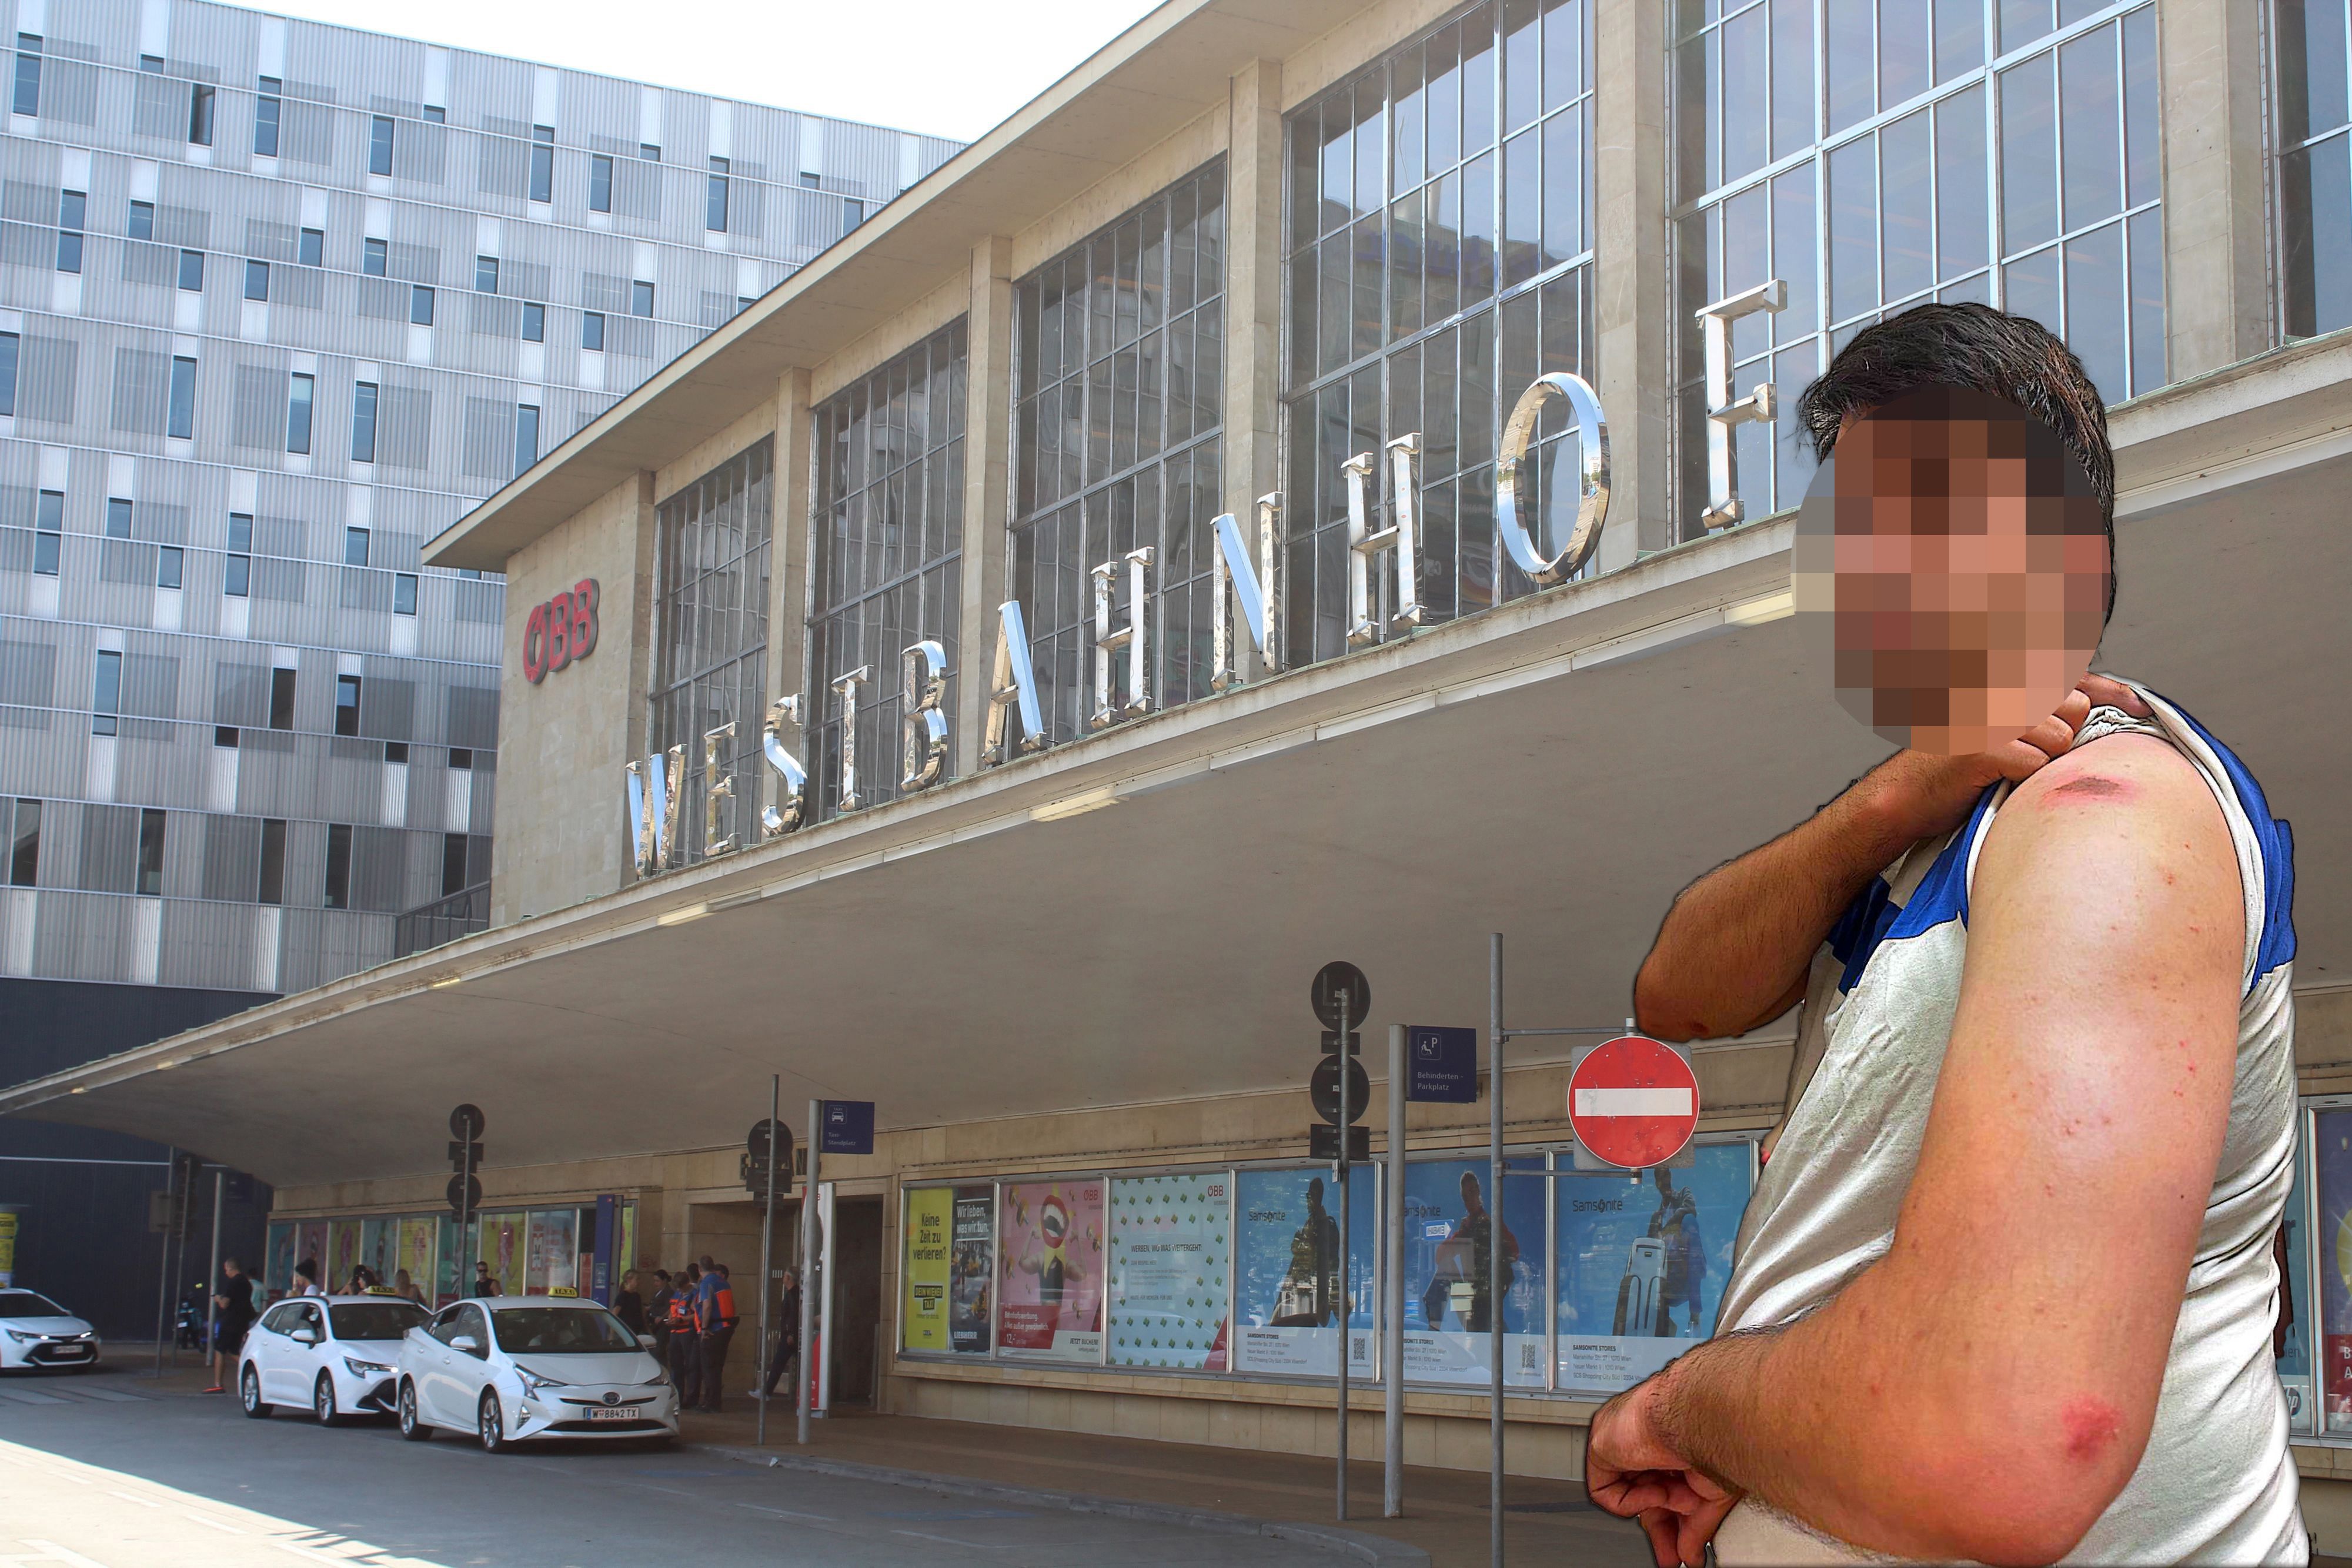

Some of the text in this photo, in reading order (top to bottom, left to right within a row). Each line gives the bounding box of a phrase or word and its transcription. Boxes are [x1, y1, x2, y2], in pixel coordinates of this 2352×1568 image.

[626, 279, 1788, 878] WESTBAHNHOF
[523, 578, 600, 684] ÖBB
[1418, 1072, 1458, 1080] Behinderten
[1418, 1083, 1449, 1091] Parkplatz
[1084, 1189, 1098, 1201] ÖBB
[1207, 1185, 1224, 1197] ÖBB
[957, 1205, 986, 1218] Wir lieben,
[1404, 1205, 1441, 1218] amsonite
[1573, 1199, 1623, 1213] Samsonite
[921, 1213, 940, 1226] Keine
[1248, 1211, 1285, 1223] Samsonite
[957, 1221, 989, 1233] was wir tun.
[920, 1230, 941, 1243] Zeit zu
[913, 1246, 947, 1260] verlieren?
[1131, 1245, 1150, 1253] WERBEN,
[924, 1299, 934, 1309] TAXI
[954, 1331, 977, 1339] LIEBHERR
[593, 1409, 636, 1418] W 8842 TX
